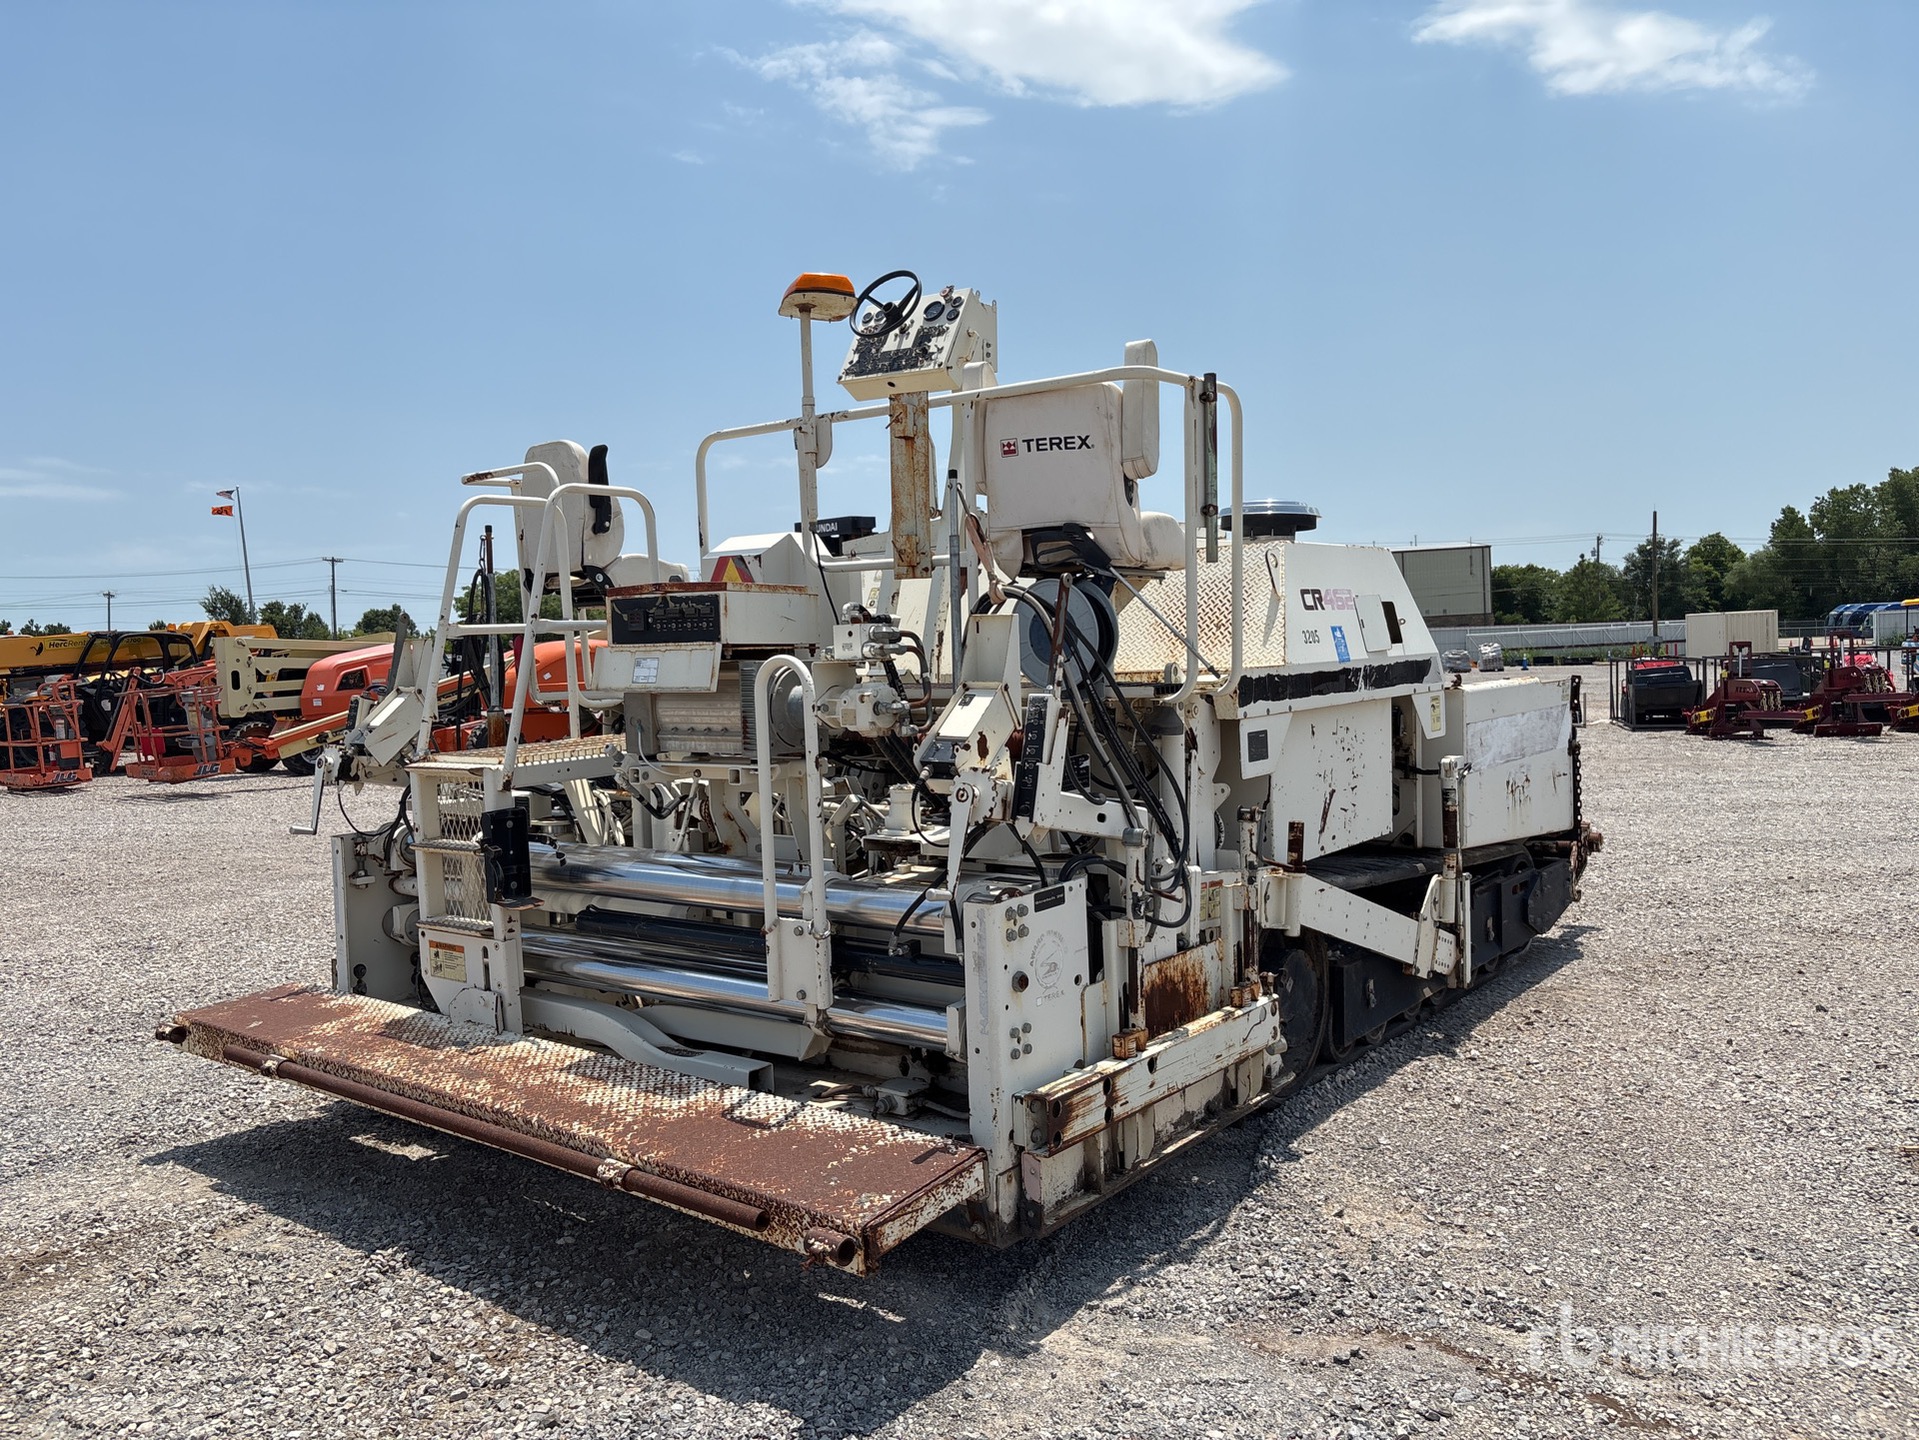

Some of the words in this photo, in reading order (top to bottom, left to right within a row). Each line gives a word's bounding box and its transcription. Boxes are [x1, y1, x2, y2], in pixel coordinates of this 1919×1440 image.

[1022, 435, 1092, 453] TEREX
[816, 522, 838, 533] UNDAI
[1302, 629, 1320, 645] 3205
[48, 639, 86, 649] HercRent
[193, 762, 221, 776] JLG
[52, 771, 78, 783] JLG
